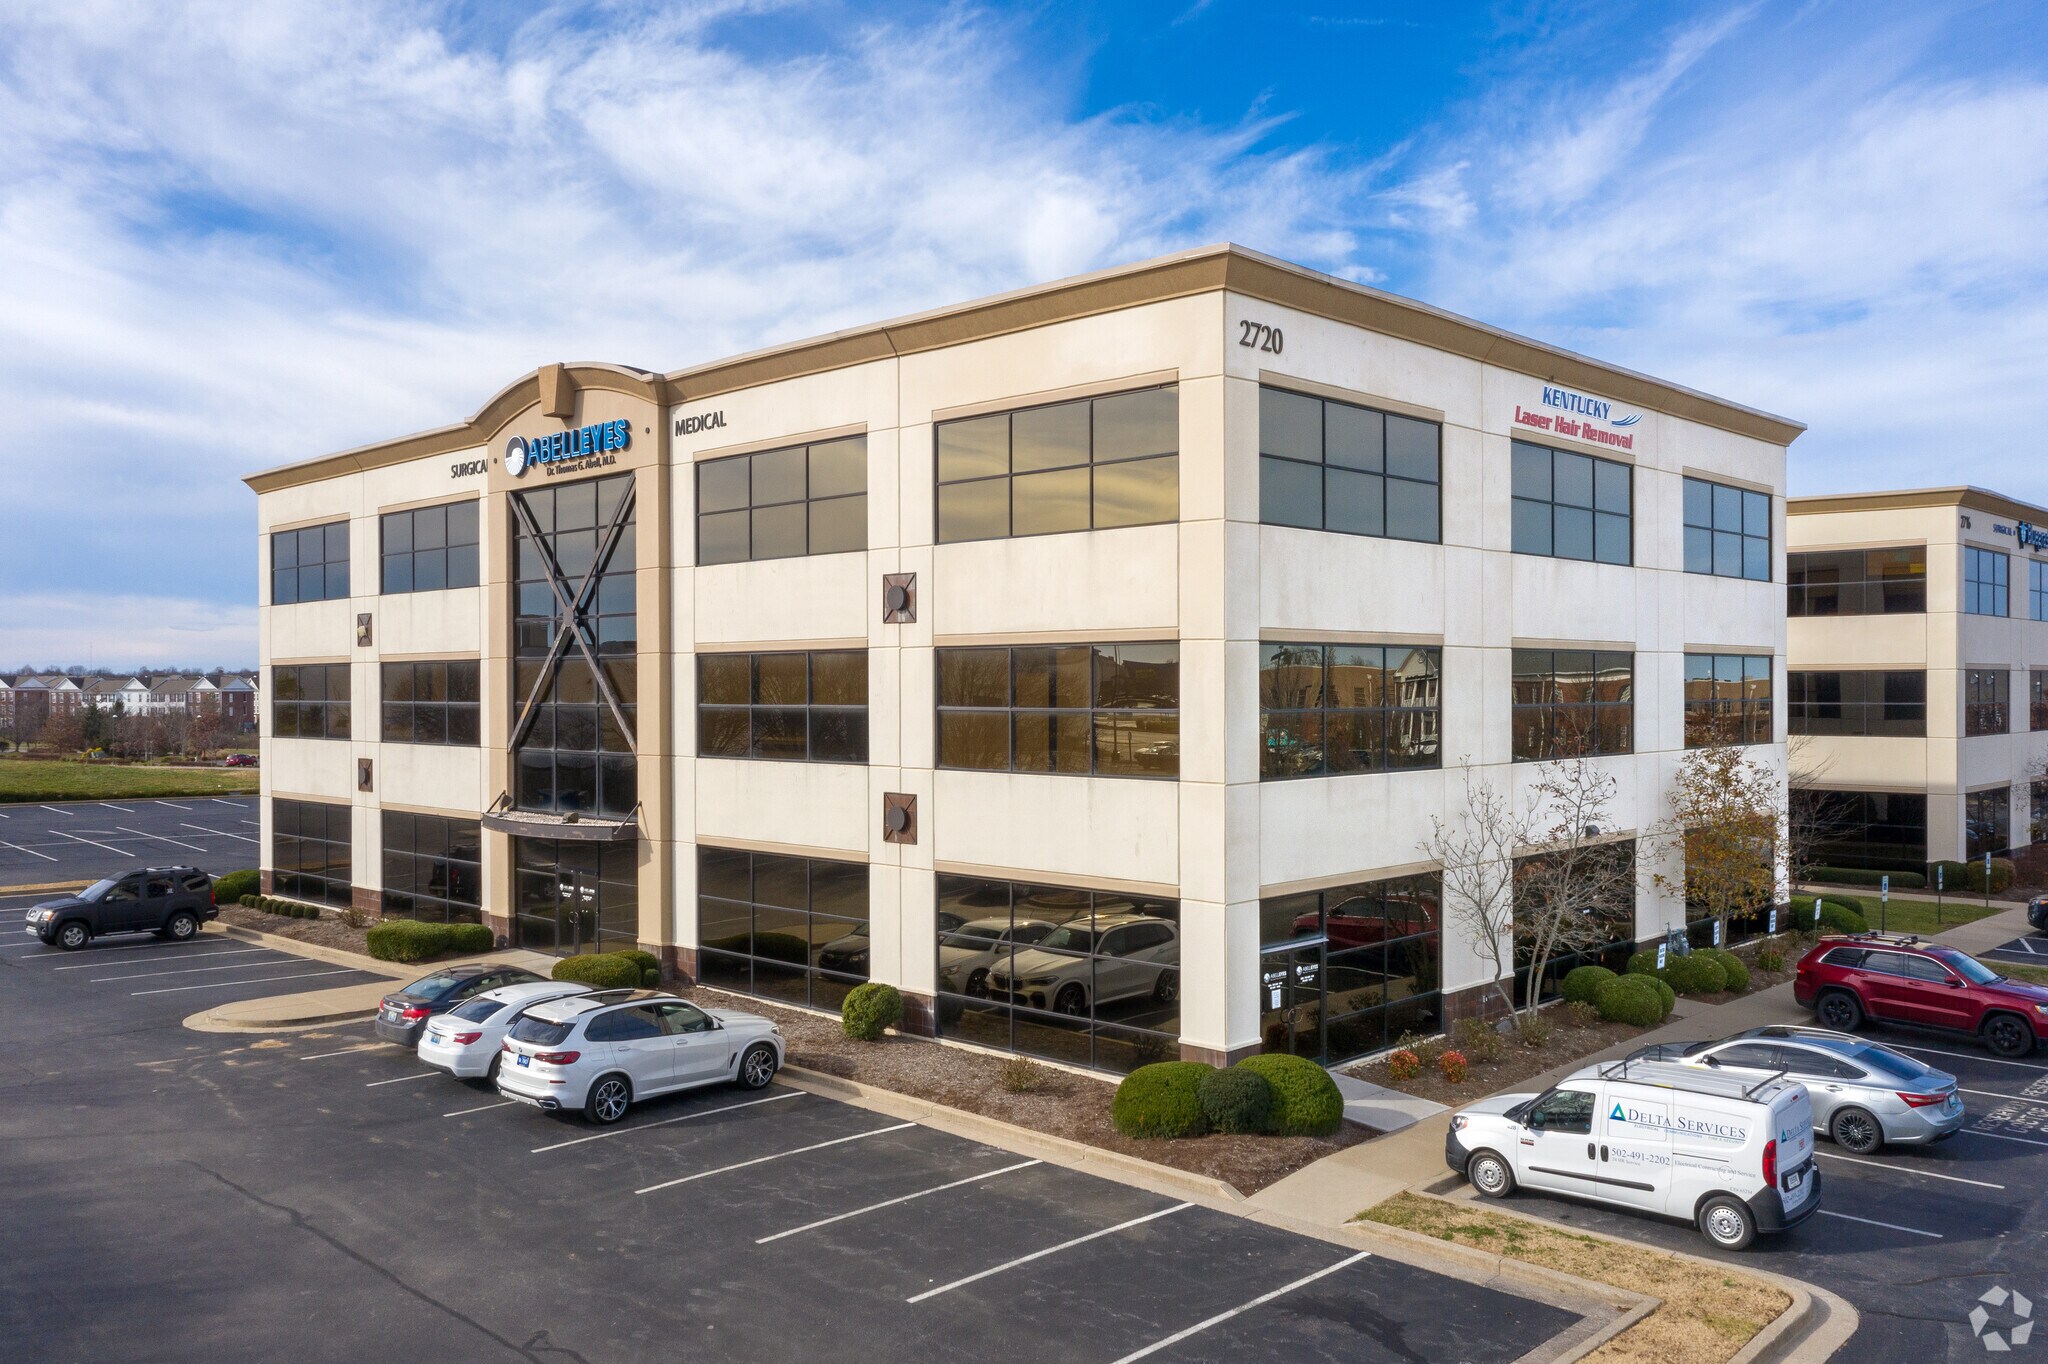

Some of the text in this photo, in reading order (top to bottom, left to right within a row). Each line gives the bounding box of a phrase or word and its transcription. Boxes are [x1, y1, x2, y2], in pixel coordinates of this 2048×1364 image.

[1239, 320, 1284, 354] 2720
[1542, 386, 1612, 420] KENTUCKY
[675, 410, 727, 437] MEDICAL
[1514, 405, 1634, 449] Laser Hair Removal
[527, 418, 629, 467] ABELLEYES
[546, 467, 555, 476] Dr.
[555, 464, 577, 475] Thomas
[578, 461, 585, 471] G.
[1628, 1108, 1746, 1139] DELTA SERVICES
[1611, 1148, 1670, 1166] 502-491-2202
[1675, 1160, 1697, 1168] Electrical
